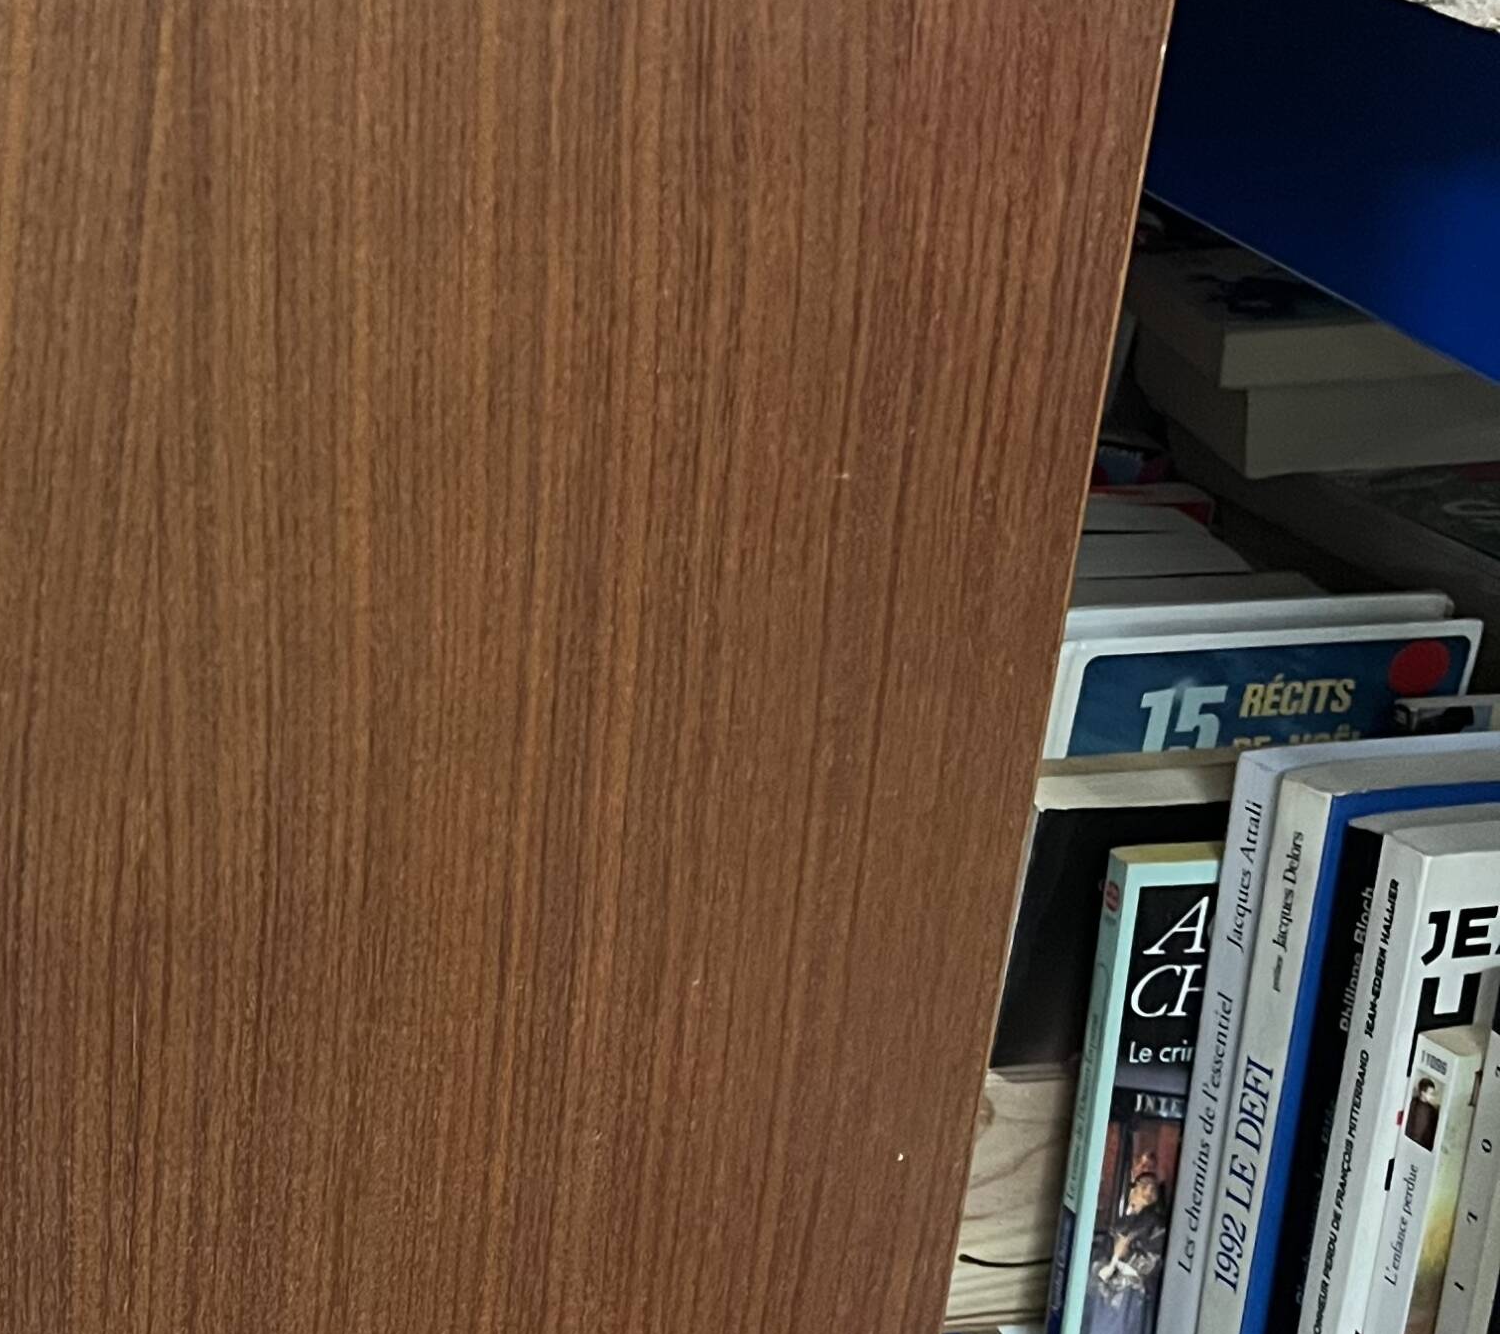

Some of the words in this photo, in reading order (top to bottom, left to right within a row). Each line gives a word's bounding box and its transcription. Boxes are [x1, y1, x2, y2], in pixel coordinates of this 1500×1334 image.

[1140, 684, 1228, 751] 15
[1239, 674, 1355, 718] RÉCITS
[1282, 831, 1304, 884] Delors
[1142, 895, 1212, 955] A
[1227, 868, 1253, 954] Jacques
[1272, 887, 1295, 953] Jacques
[1421, 905, 1500, 966] JE
[1129, 1040, 1153, 1063] Le
[1201, 991, 1234, 1103] l'essentiel
[1198, 1107, 1216, 1136] de
[1184, 1139, 1211, 1235] chemins
[1225, 1154, 1257, 1213] LE
[1177, 1237, 1196, 1274] Les
[1213, 1212, 1247, 1294] 1992
[1325, 1234, 1339, 1280] PERDU
[1332, 1214, 1342, 1232] DE
[1384, 1214, 1409, 1287] L'enfance
[1402, 1164, 1419, 1215] perdue
